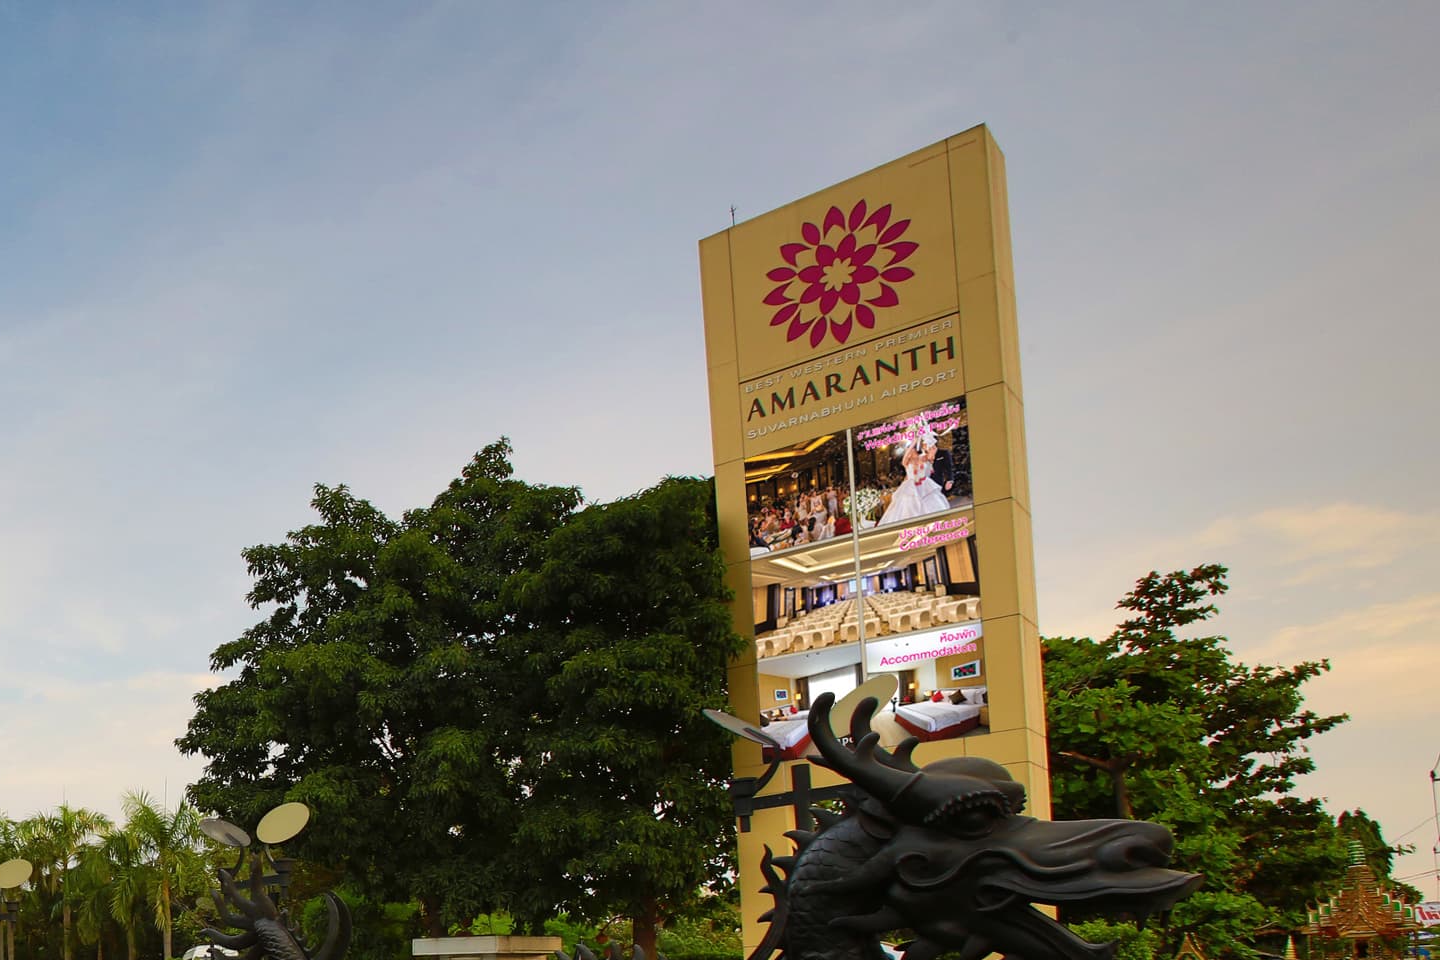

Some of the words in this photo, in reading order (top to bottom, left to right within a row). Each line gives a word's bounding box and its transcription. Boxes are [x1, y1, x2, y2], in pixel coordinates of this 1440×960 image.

[745, 376, 782, 393] BEST
[791, 349, 867, 377] WESTERN
[875, 320, 952, 350] PREMIER
[747, 336, 955, 422] AMARANTH
[746, 396, 874, 440] SUVARNABHUMI
[881, 368, 956, 398] AIRPORT
[864, 431, 915, 451] Wedding
[899, 529, 969, 551] Conference
[940, 629, 976, 643] ห้องพัก
[880, 643, 976, 666] Accommodation
